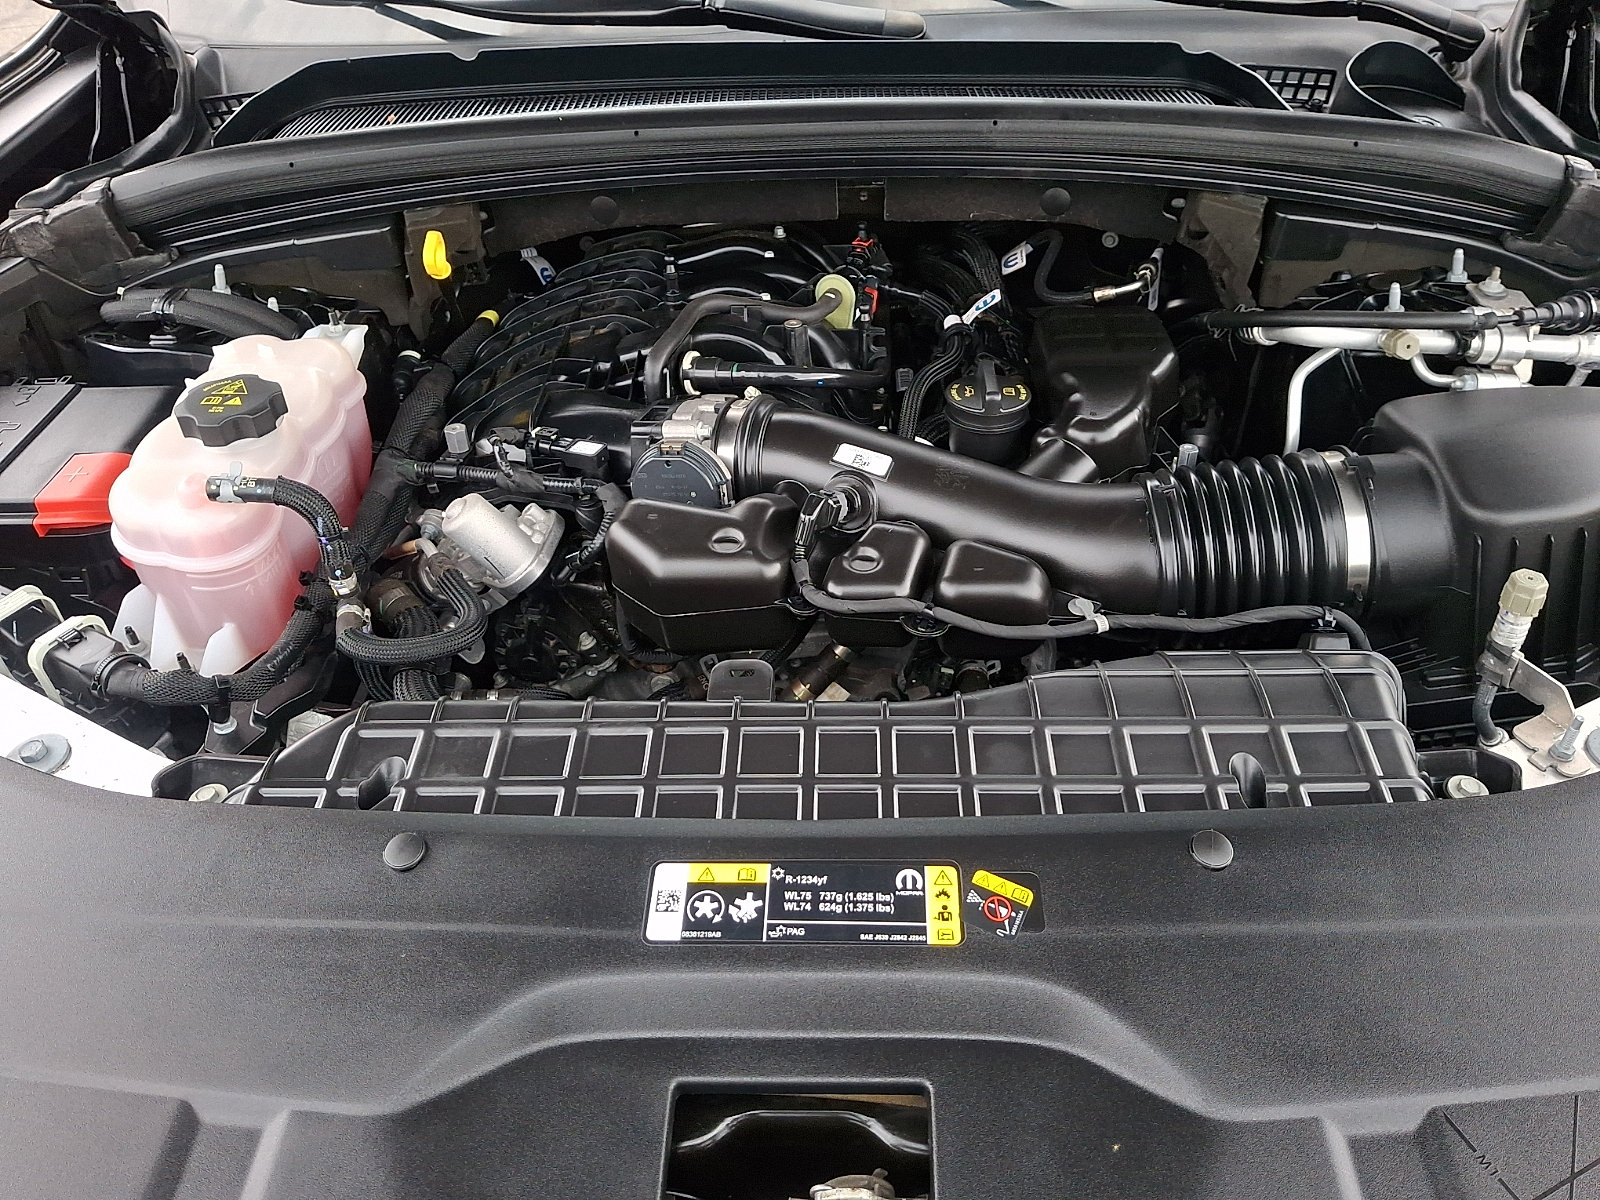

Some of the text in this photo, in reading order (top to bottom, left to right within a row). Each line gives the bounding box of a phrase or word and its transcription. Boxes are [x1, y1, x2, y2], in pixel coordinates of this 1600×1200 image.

[785, 874, 828, 886] R-1234yf
[784, 891, 895, 903] WL75 737g (1.625 lbs)
[783, 902, 895, 914] WL74 624g (1.375 lbs)
[786, 927, 806, 936] PAG
